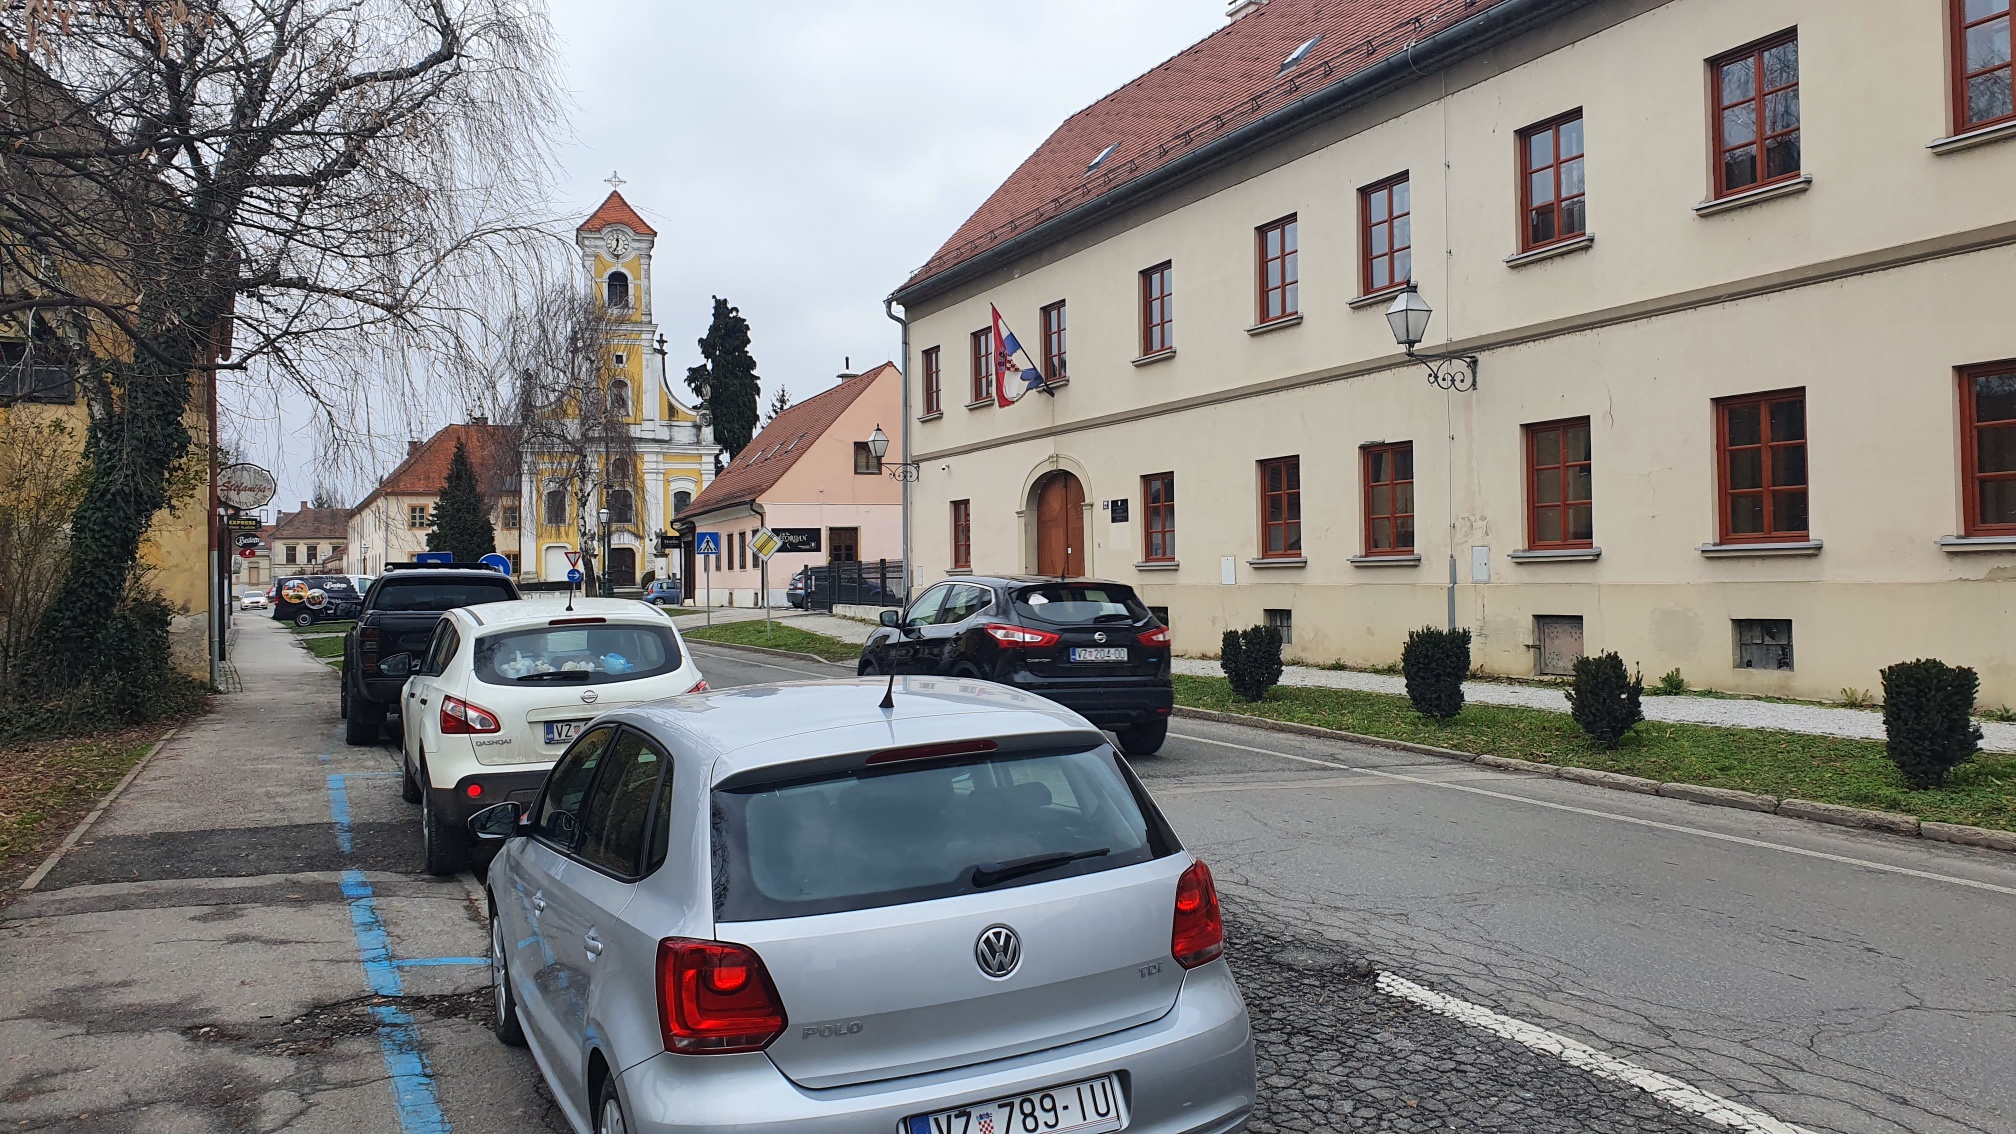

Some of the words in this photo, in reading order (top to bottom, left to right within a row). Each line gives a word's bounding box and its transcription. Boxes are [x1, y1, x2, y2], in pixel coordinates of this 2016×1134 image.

[555, 723, 573, 739] VZ
[475, 738, 512, 748] QASHQAI
[1138, 960, 1164, 979] TDI
[802, 1020, 864, 1040] POLO
[997, 1080, 1112, 1134] 789-IU
